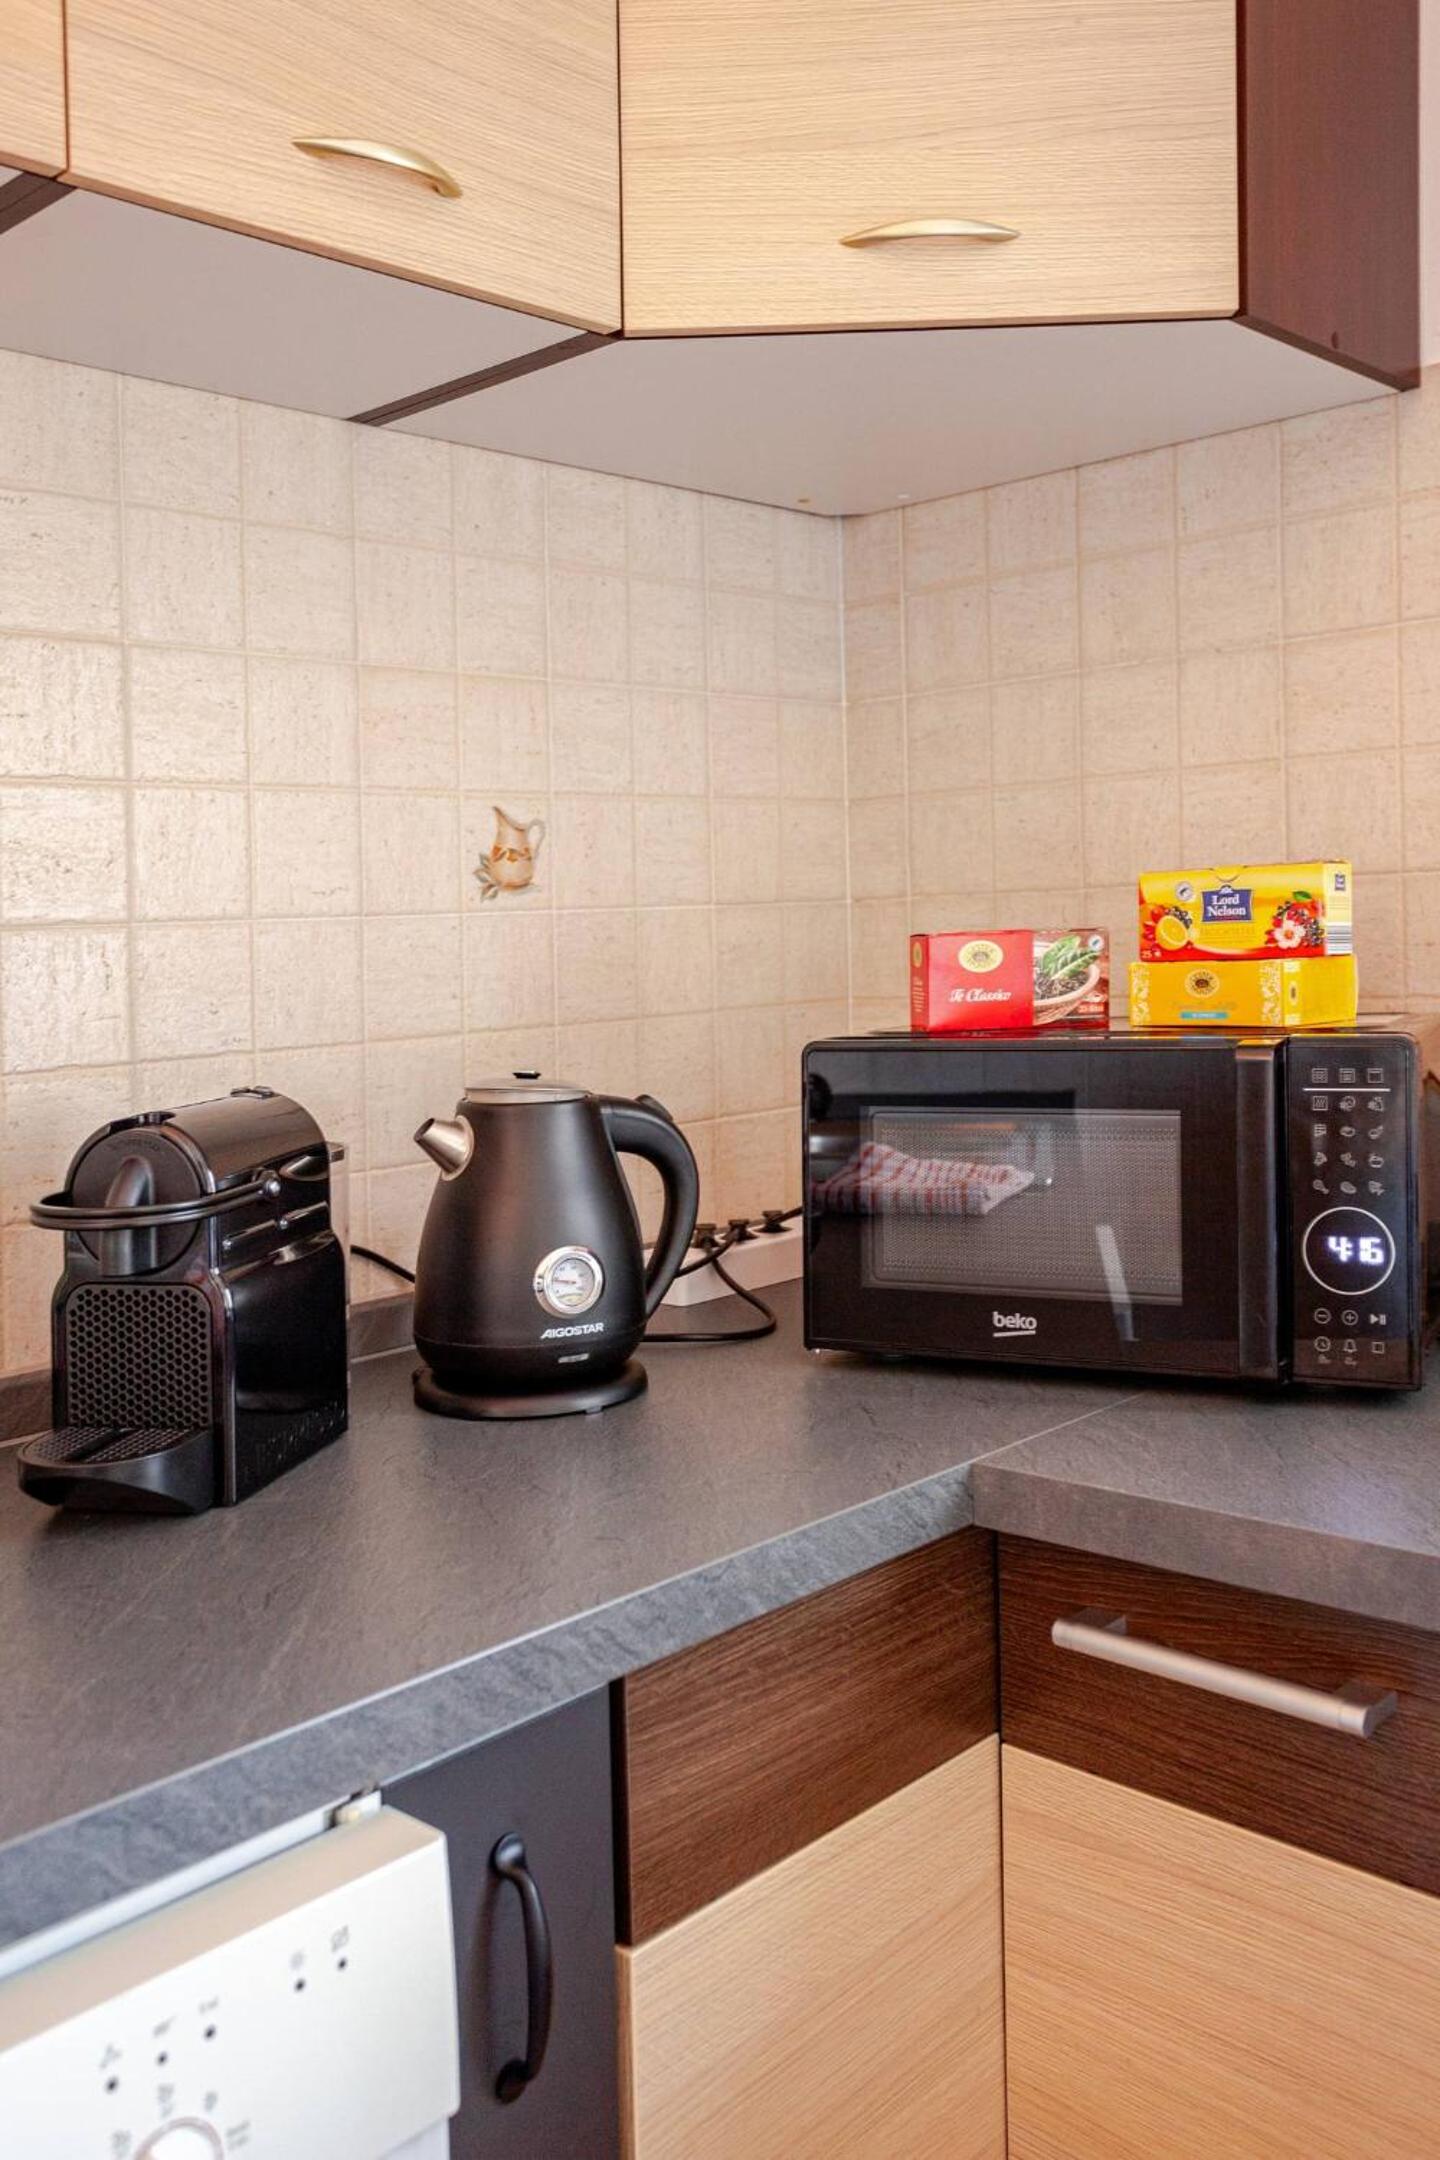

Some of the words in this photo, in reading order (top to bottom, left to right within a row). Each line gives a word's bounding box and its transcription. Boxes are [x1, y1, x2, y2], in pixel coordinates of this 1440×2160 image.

[1211, 893, 1240, 905] Lord
[1207, 905, 1247, 917] Nelson
[992, 1311, 1038, 1330] beko
[541, 1322, 604, 1339] AIGOSTAR
